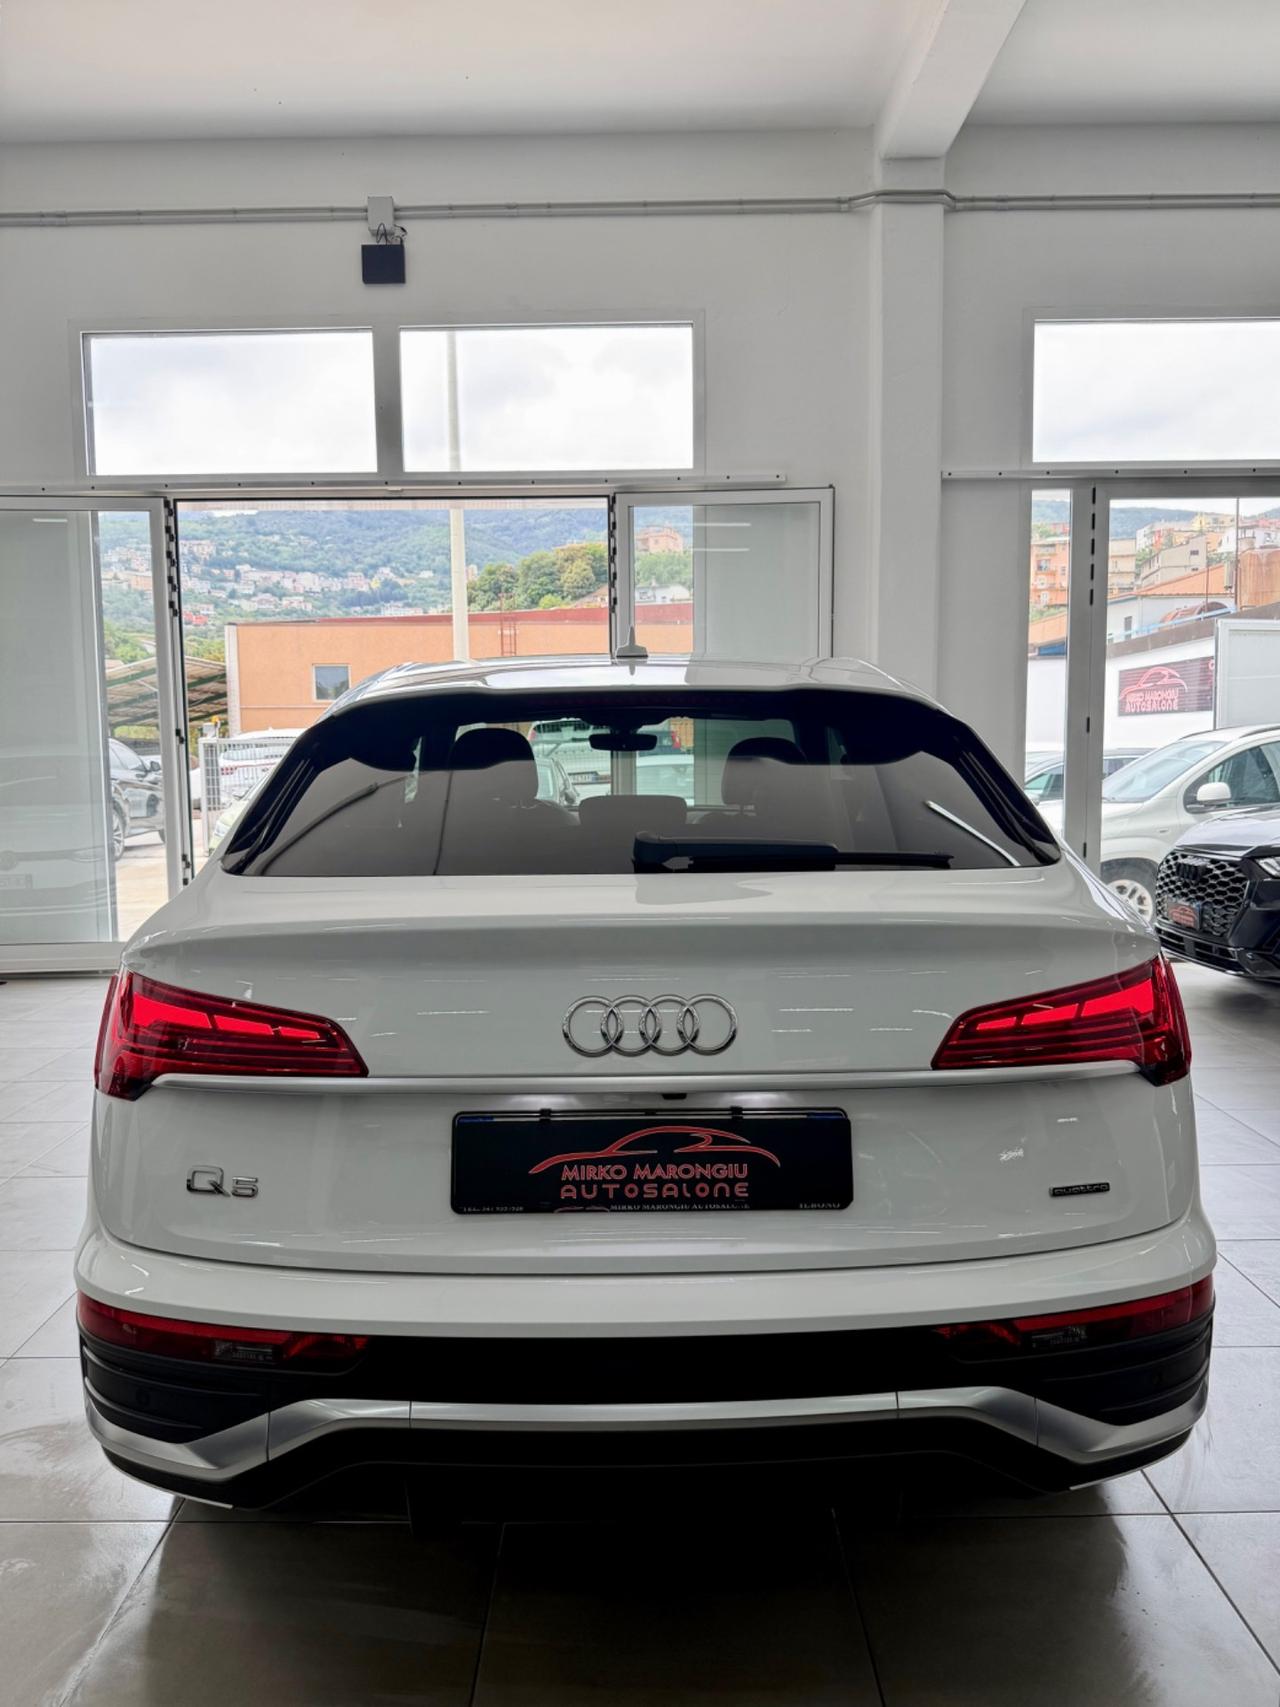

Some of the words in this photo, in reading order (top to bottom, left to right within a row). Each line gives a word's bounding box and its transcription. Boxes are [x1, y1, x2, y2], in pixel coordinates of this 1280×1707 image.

[561, 1164, 628, 1181] MIRKO
[633, 1163, 748, 1180] MARONGIU
[186, 1165, 259, 1198] Q5
[560, 1182, 749, 1199] AUTOSALONE
